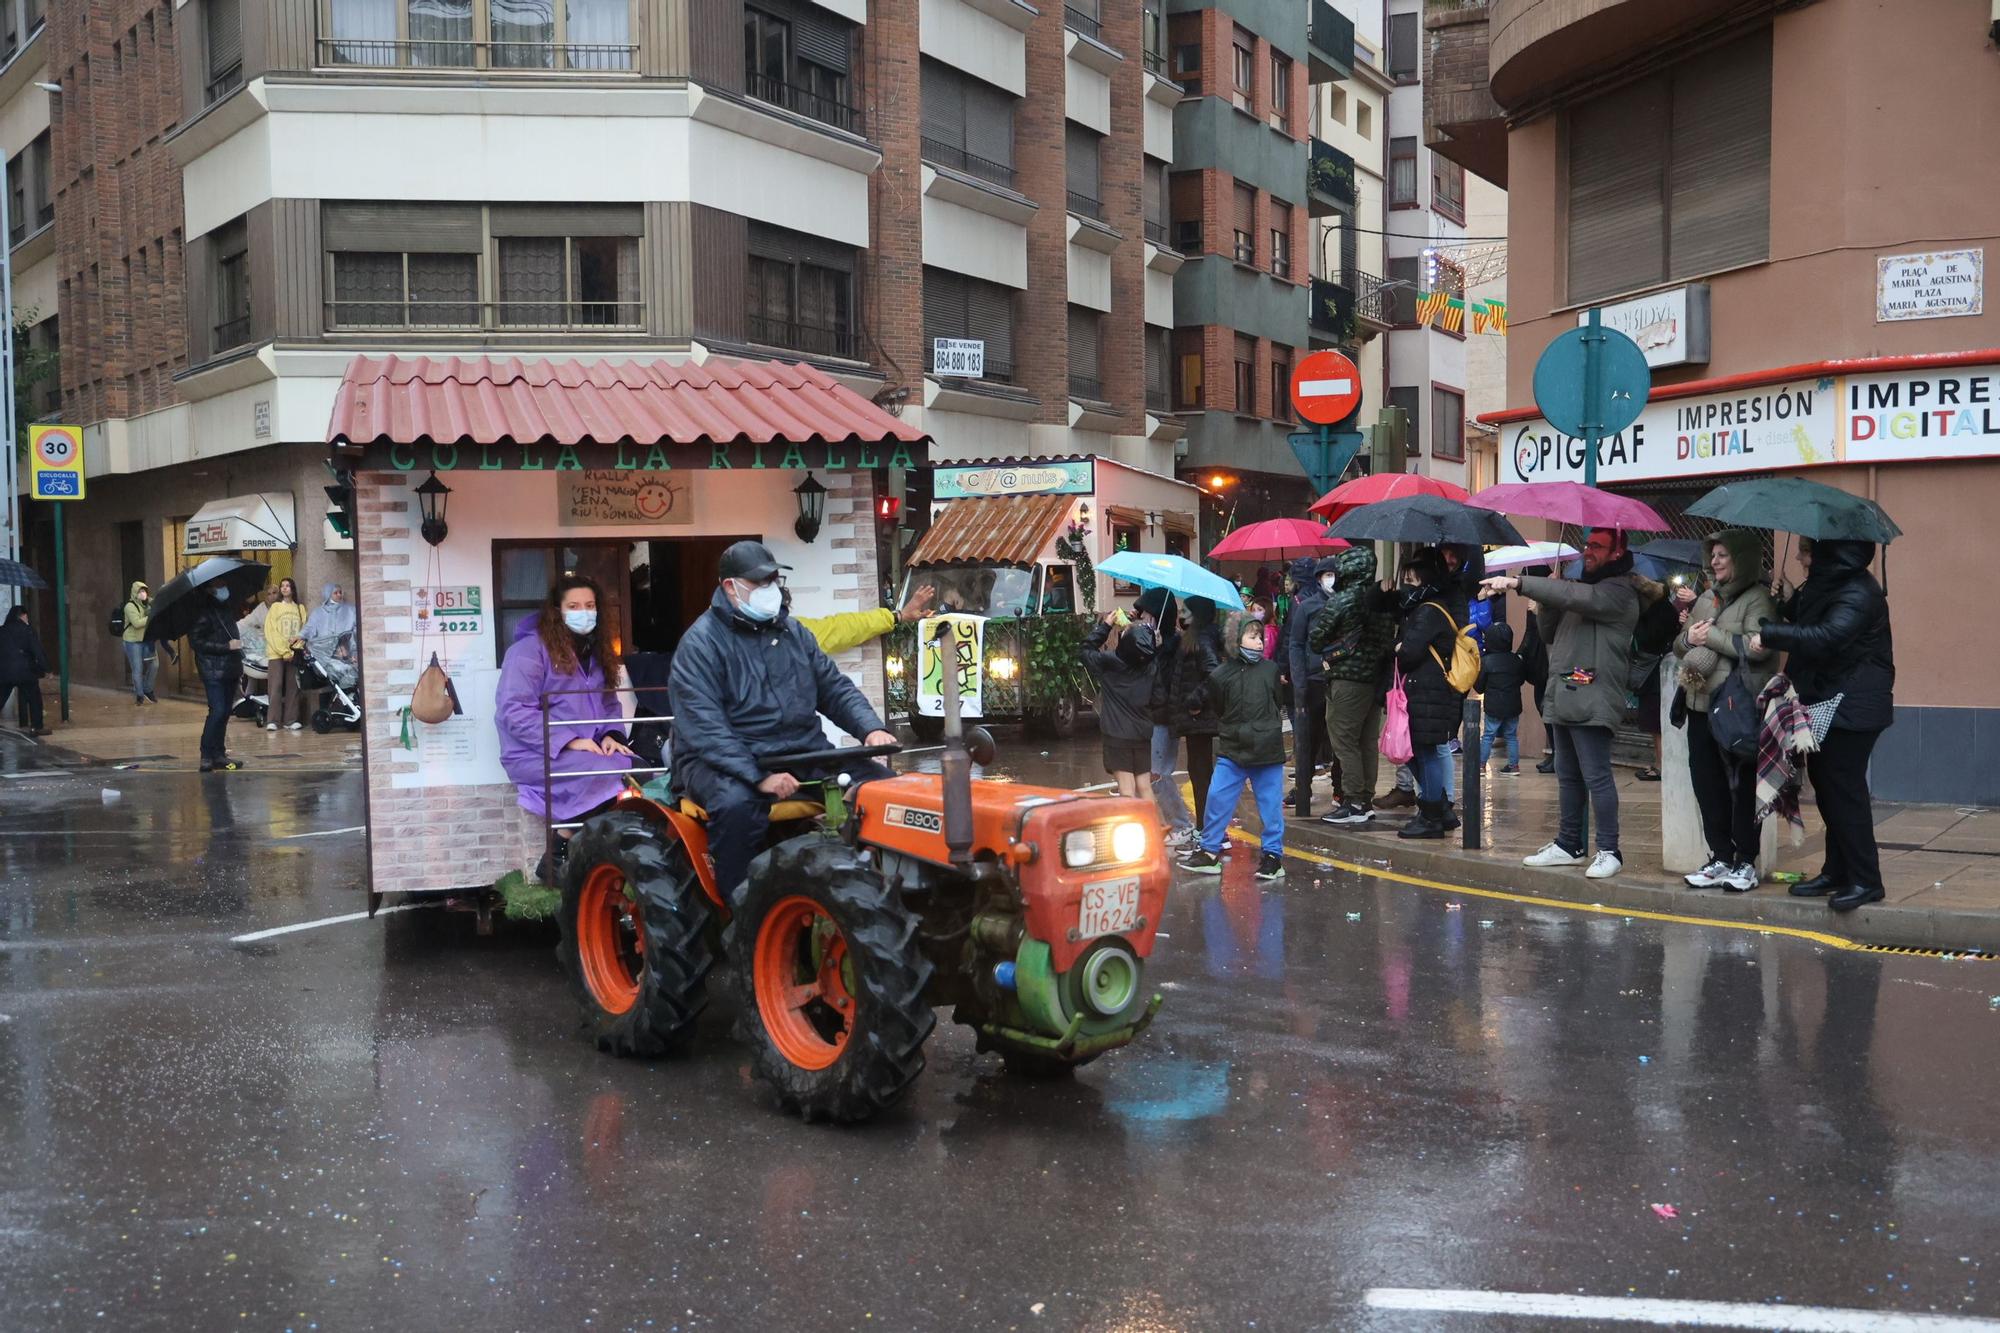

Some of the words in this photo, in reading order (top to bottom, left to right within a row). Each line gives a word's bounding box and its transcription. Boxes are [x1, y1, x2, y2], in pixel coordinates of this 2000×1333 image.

[1902, 268, 1928, 278] PLAÇA
[1946, 265, 1958, 274] DE
[1891, 279, 1921, 289] MARIA
[1930, 274, 1972, 285] AGUSTINA
[1914, 288, 1942, 298] PLAZA
[1888, 301, 1917, 310] MARIA
[1925, 297, 1968, 308] AGUSTINA
[936, 350, 950, 369] 864
[951, 352, 965, 370] 880
[968, 353, 981, 371] 183
[1852, 377, 2000, 410] IMPRE
[1677, 387, 1813, 431] IMPRESIÓN
[1851, 408, 2000, 441] DIGITAL
[45, 442, 68, 455] 30
[1677, 429, 1754, 460] DIGITAL
[390, 442, 584, 471] COLLA
[614, 442, 672, 471] LA
[708, 442, 916, 470] RIALLA
[242, 540, 277, 548] SABANAS
[435, 591, 463, 608] 051
[439, 621, 478, 632] 2022
[905, 811, 941, 829] 8900
[1084, 906, 1134, 934] 11624
